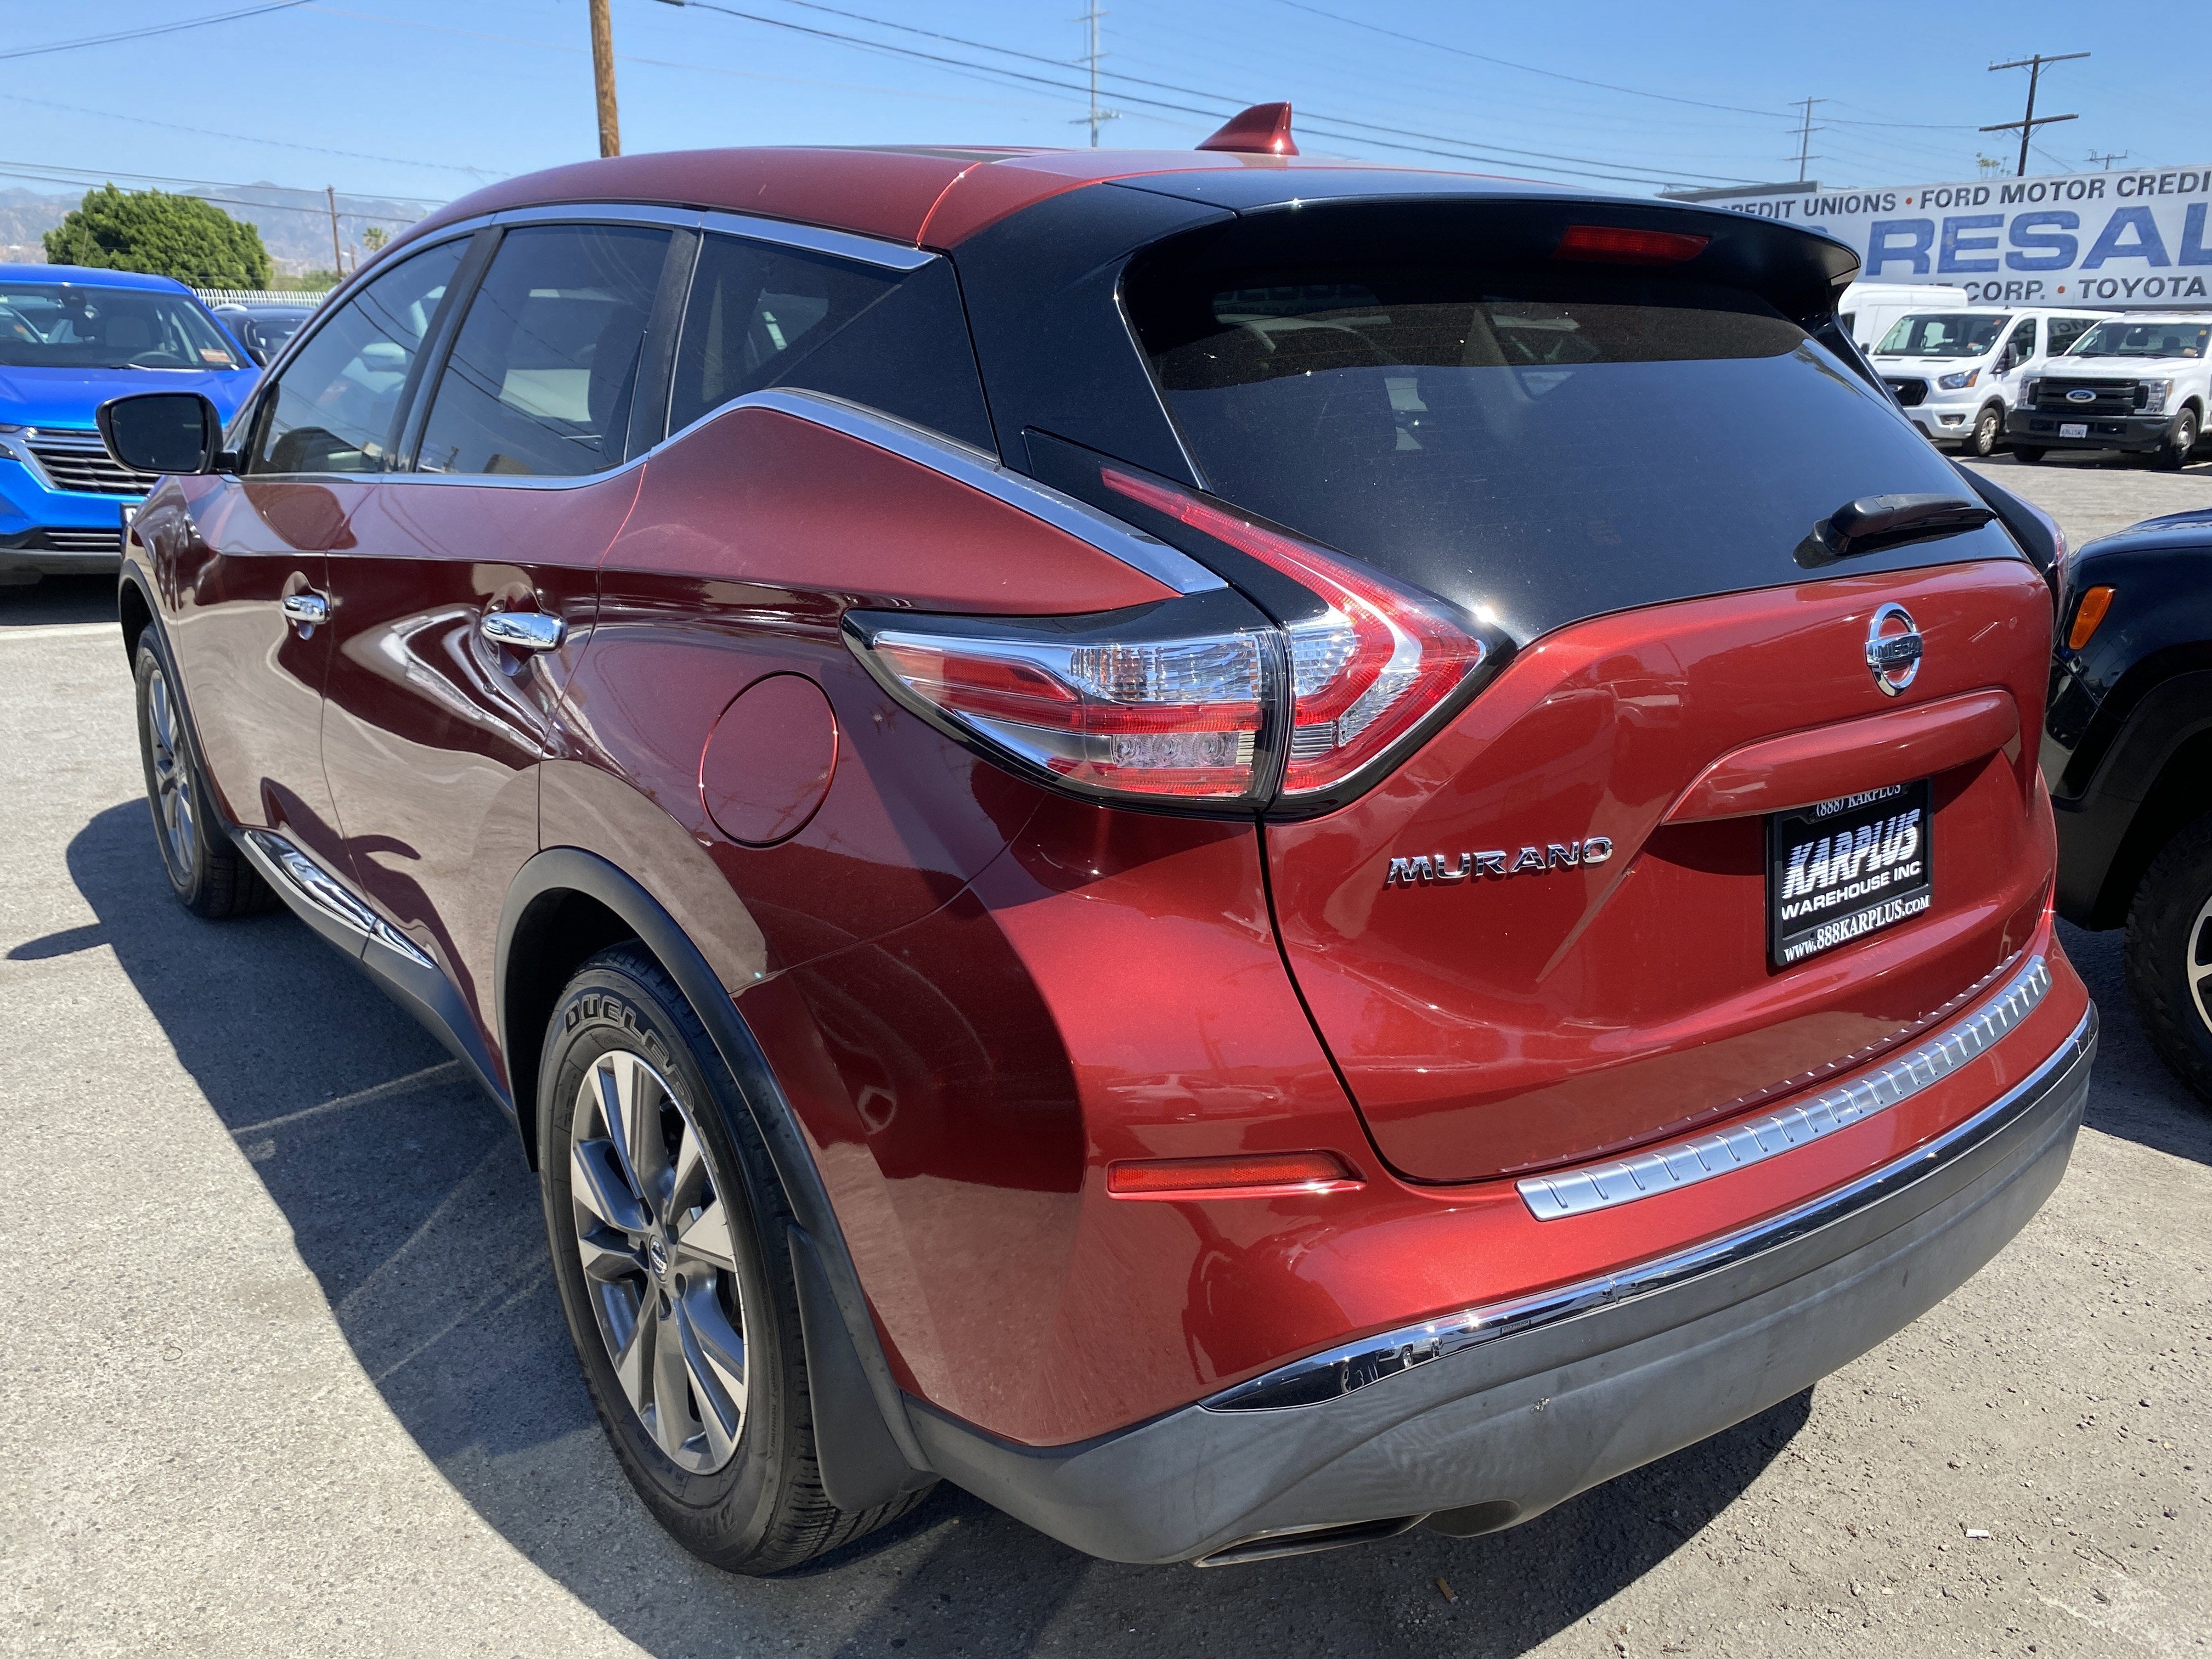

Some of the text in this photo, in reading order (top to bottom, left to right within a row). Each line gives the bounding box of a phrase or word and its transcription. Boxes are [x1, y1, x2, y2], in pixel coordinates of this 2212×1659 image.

[1721, 200, 1796, 219] EDIT
[1804, 193, 1896, 216] UNIONS
[1920, 186, 1990, 209] FORD
[2000, 178, 2106, 204] MOTOR
[1865, 202, 2212, 276] RESAL
[1963, 276, 2207, 302] CORP. TOYOTA
[1816, 798, 1844, 817] (888)
[1386, 836, 1613, 884] MURANO
[1782, 809, 1921, 900] KARPLUS
[1781, 860, 1921, 921] WAREHOUSE INC
